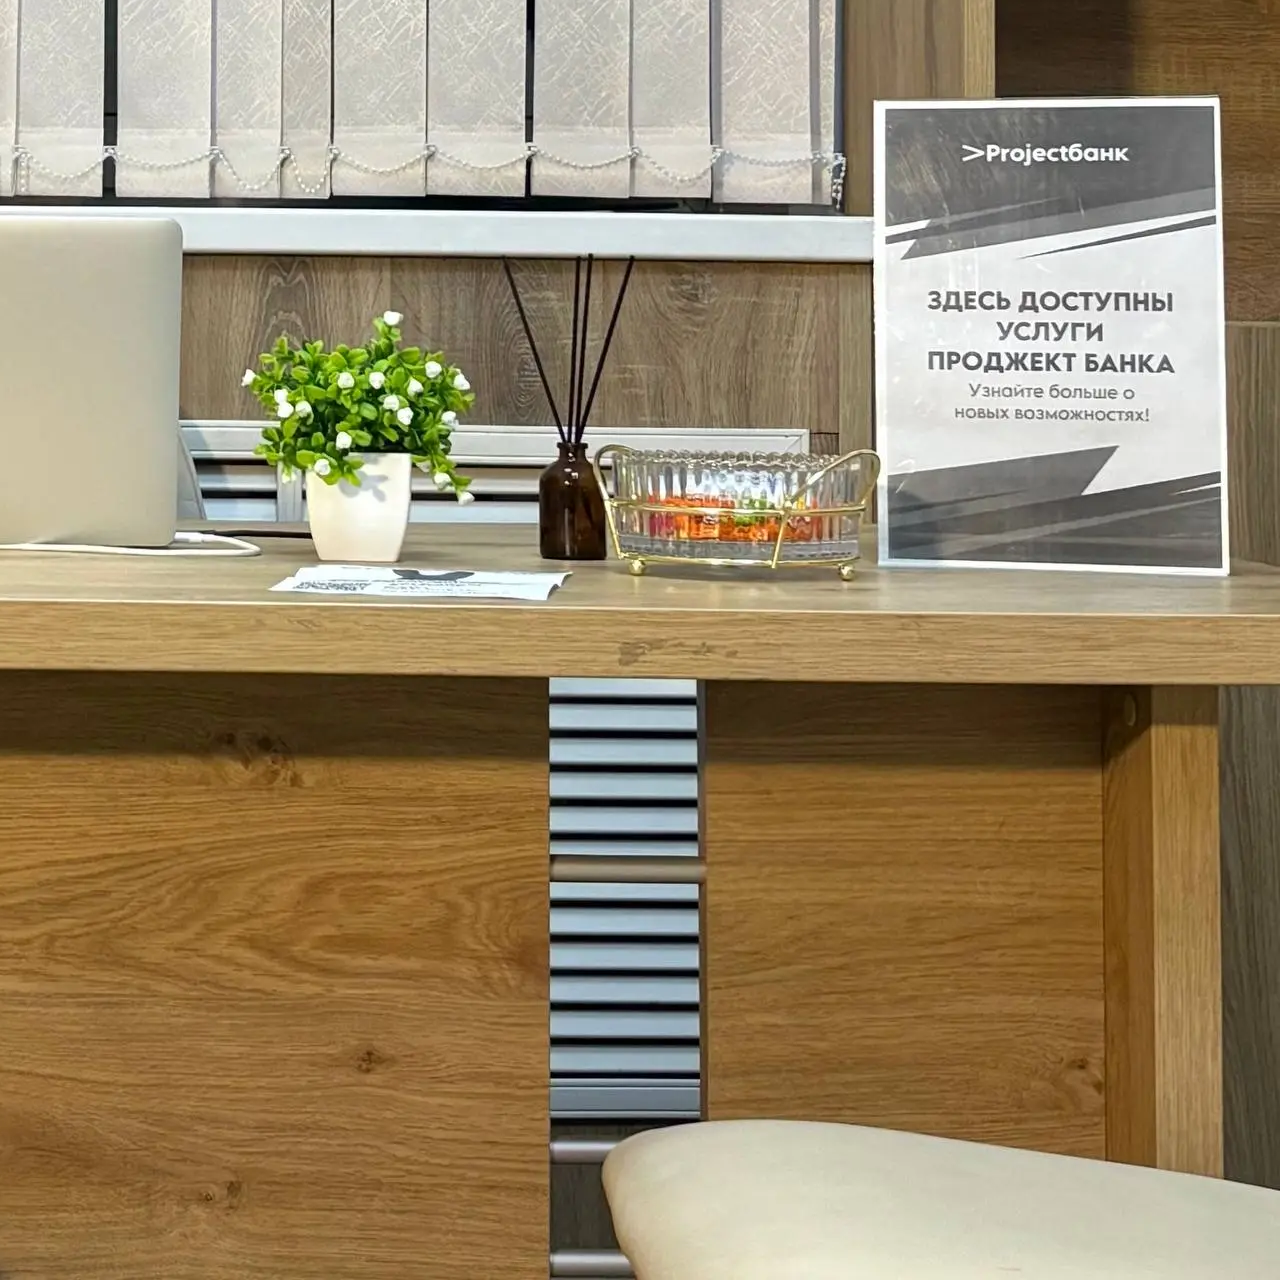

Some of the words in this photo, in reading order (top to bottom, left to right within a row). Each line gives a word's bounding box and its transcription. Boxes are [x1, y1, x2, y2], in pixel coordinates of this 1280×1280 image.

[927, 290, 1011, 313] ЗДЕСЬ
[1018, 291, 1173, 314] ДОСТУПНЫ
[996, 321, 1104, 342] УСЛУГИ
[928, 351, 1077, 374] ПРОДЖЕКТ
[1084, 353, 1176, 374] БАНКА
[968, 383, 1044, 399] Узнайте
[1049, 383, 1118, 400] больше
[1123, 388, 1135, 400] о
[955, 407, 1010, 420] новых
[1015, 407, 1150, 422] возможностях!
